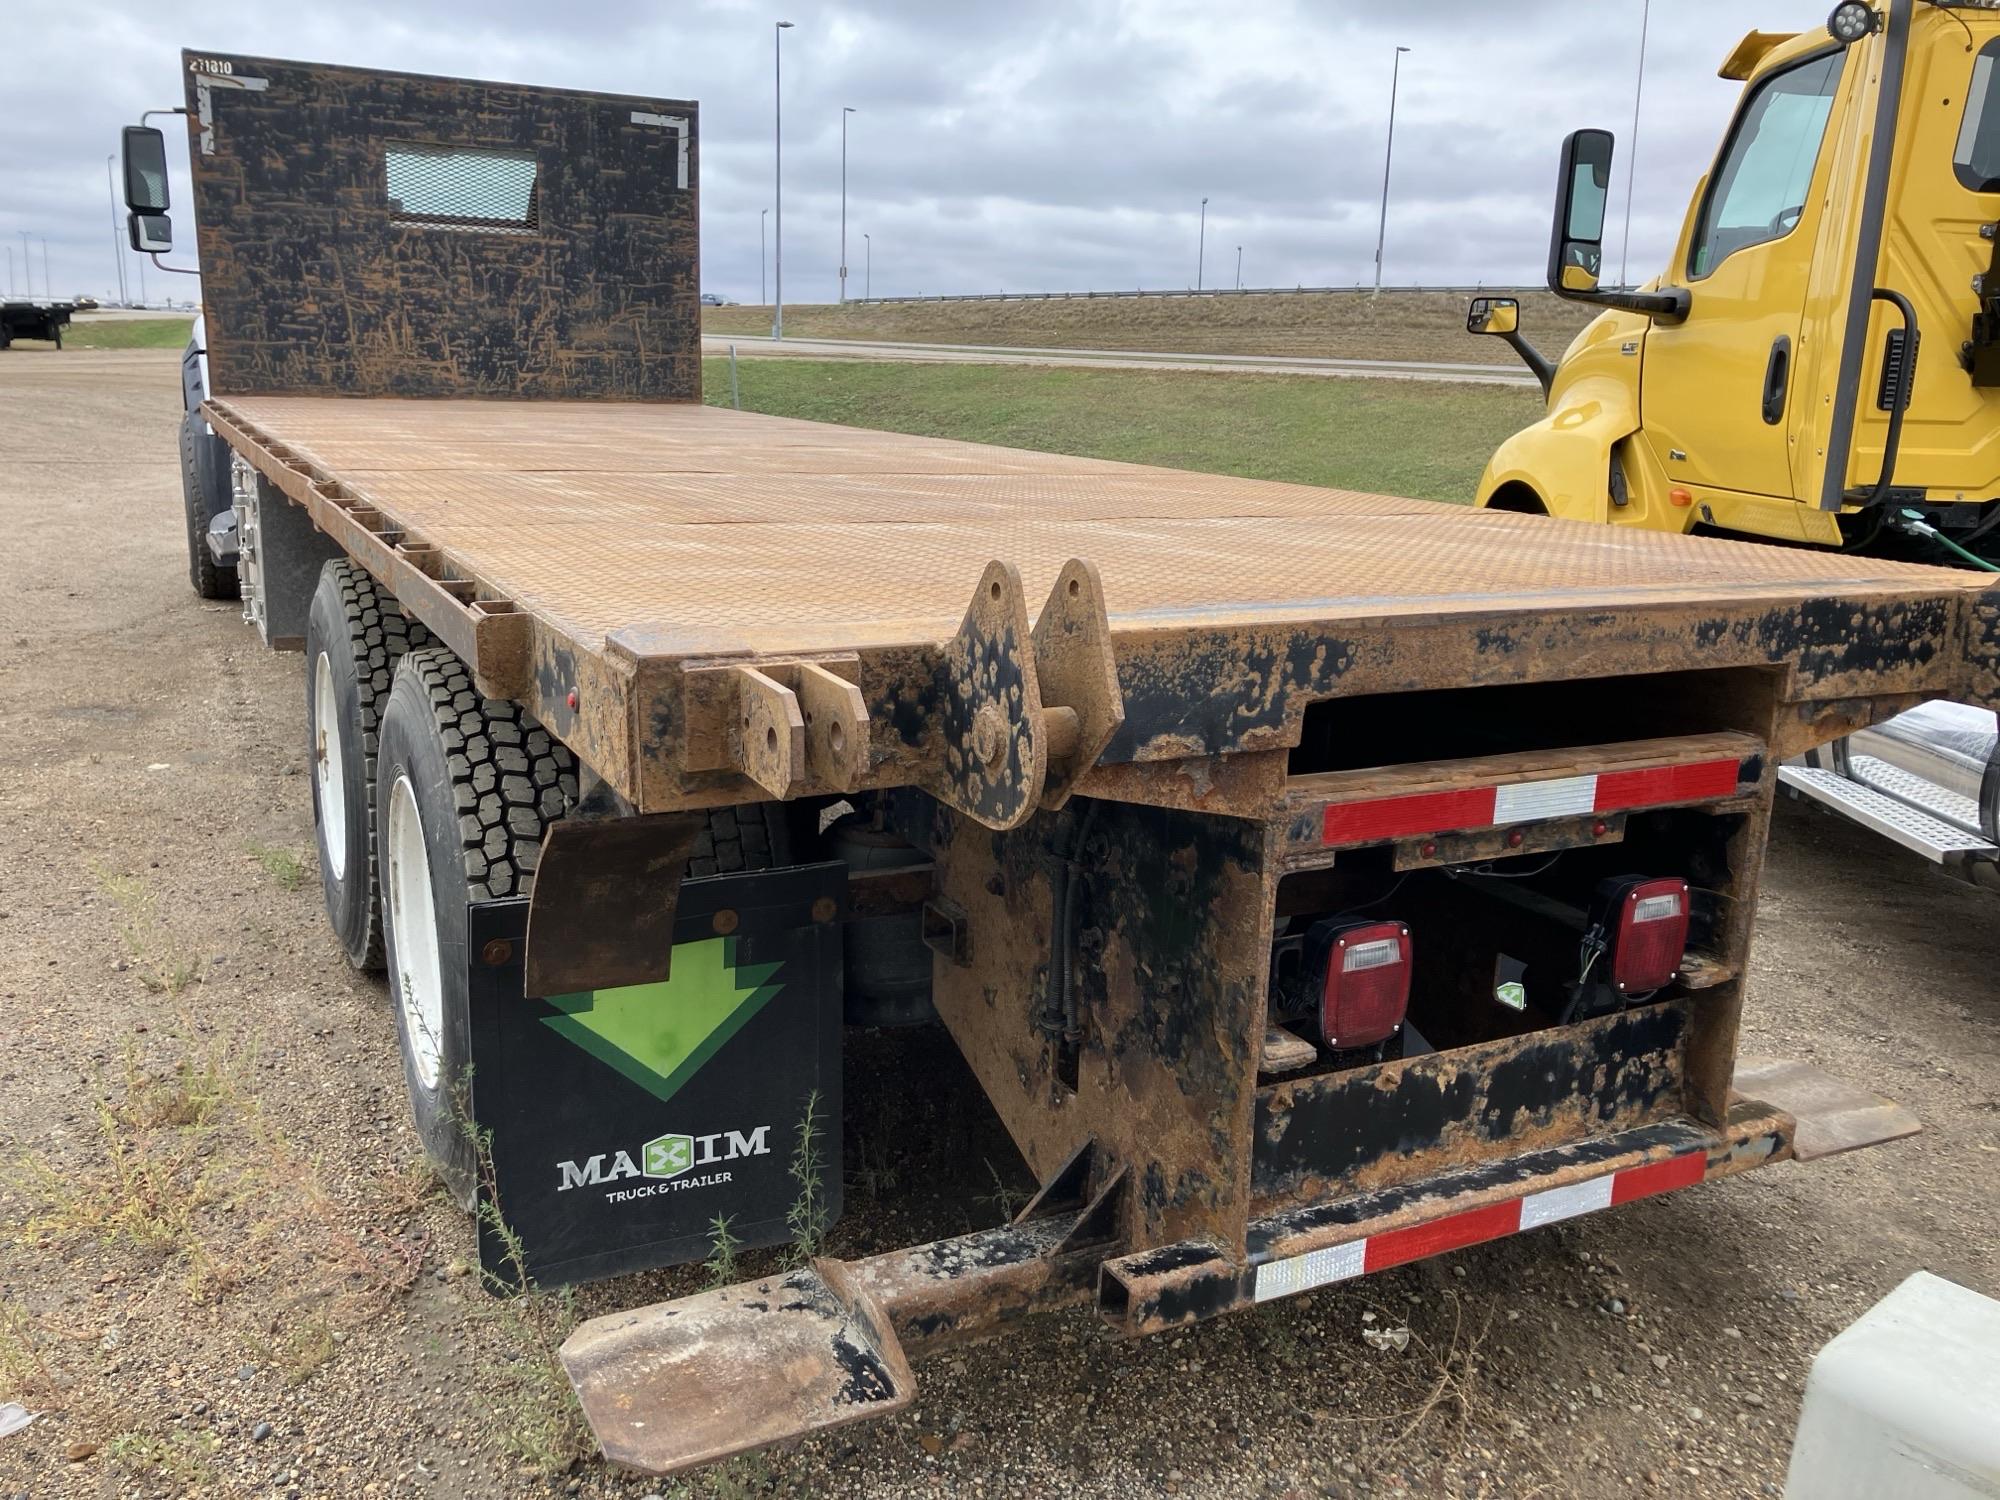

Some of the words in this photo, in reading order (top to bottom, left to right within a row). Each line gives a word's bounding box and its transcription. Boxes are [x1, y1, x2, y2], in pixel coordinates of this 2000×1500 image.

[556, 1125, 771, 1191] MAXIM
[605, 1185, 657, 1204] TRUCK
[658, 1183, 670, 1194] &
[670, 1172, 733, 1192] TRAILER
